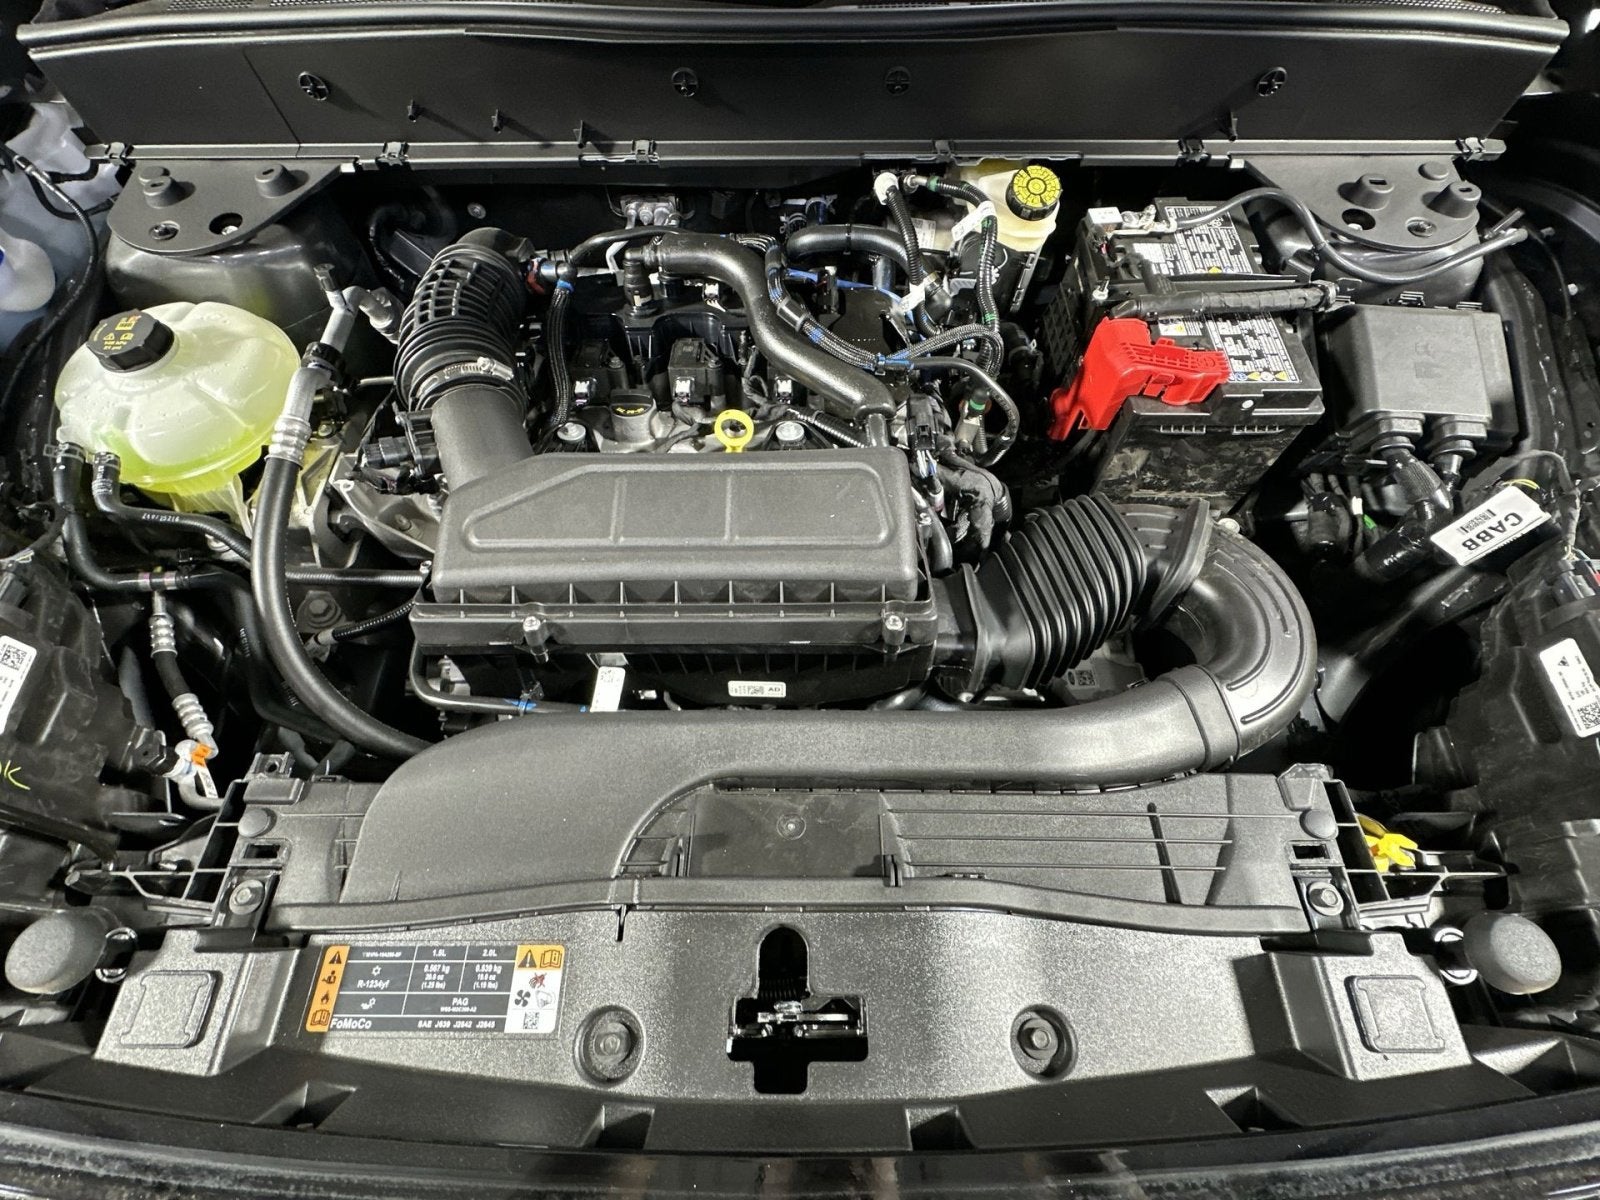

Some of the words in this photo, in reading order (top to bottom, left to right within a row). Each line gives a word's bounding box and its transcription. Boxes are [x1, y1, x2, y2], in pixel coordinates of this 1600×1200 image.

[1462, 512, 1523, 551] CABB
[0, 759, 31, 790] K
[482, 949, 498, 957] 2.0L
[441, 964, 450, 974] kg
[493, 964, 502, 974] kg
[357, 980, 390, 990] R-1234yf
[452, 998, 469, 1006] PAG
[330, 1018, 372, 1029] FoMoCo
[418, 1020, 432, 1028] SAE
[434, 1020, 451, 1028] J639
